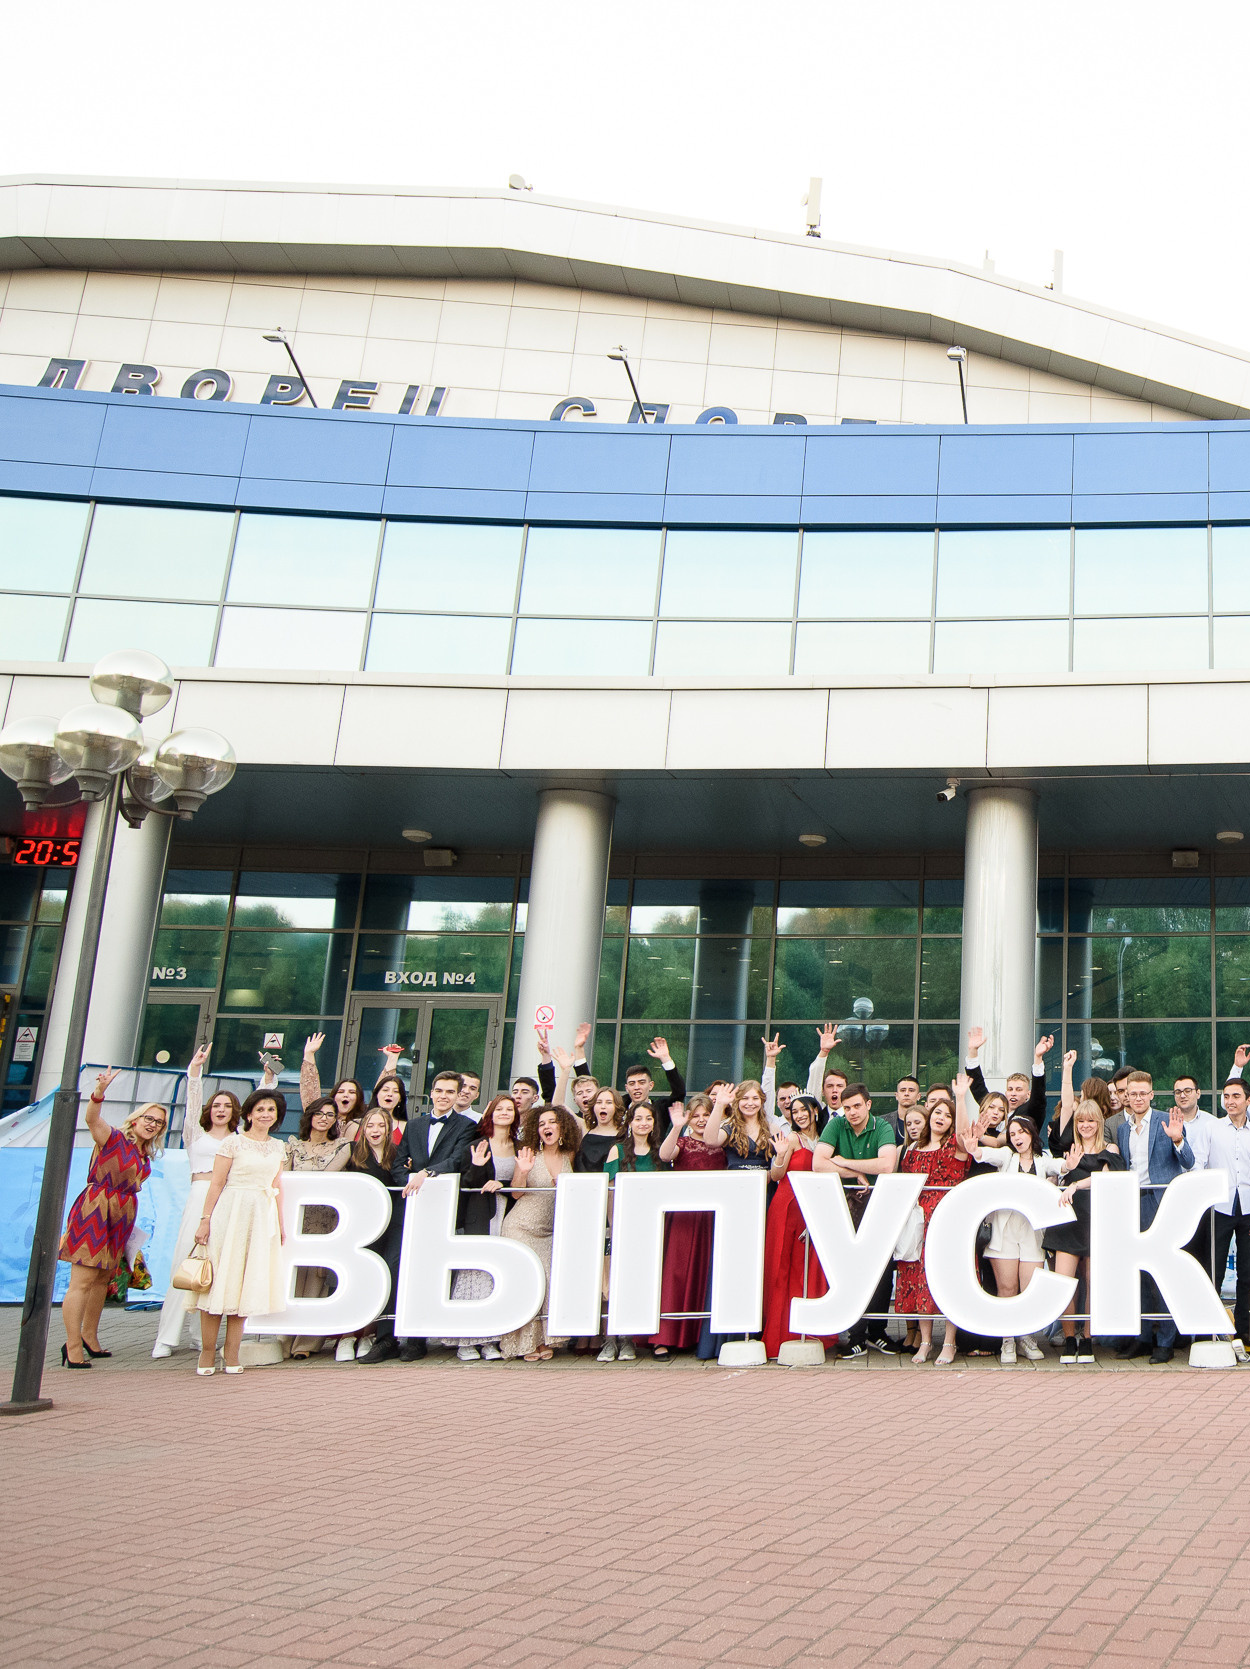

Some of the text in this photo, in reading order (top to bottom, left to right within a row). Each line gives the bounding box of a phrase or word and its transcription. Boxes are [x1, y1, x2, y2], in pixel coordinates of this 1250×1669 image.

[15, 839, 80, 866] 20:5
[152, 966, 187, 980] №3
[384, 971, 476, 987] ВХОД №4
